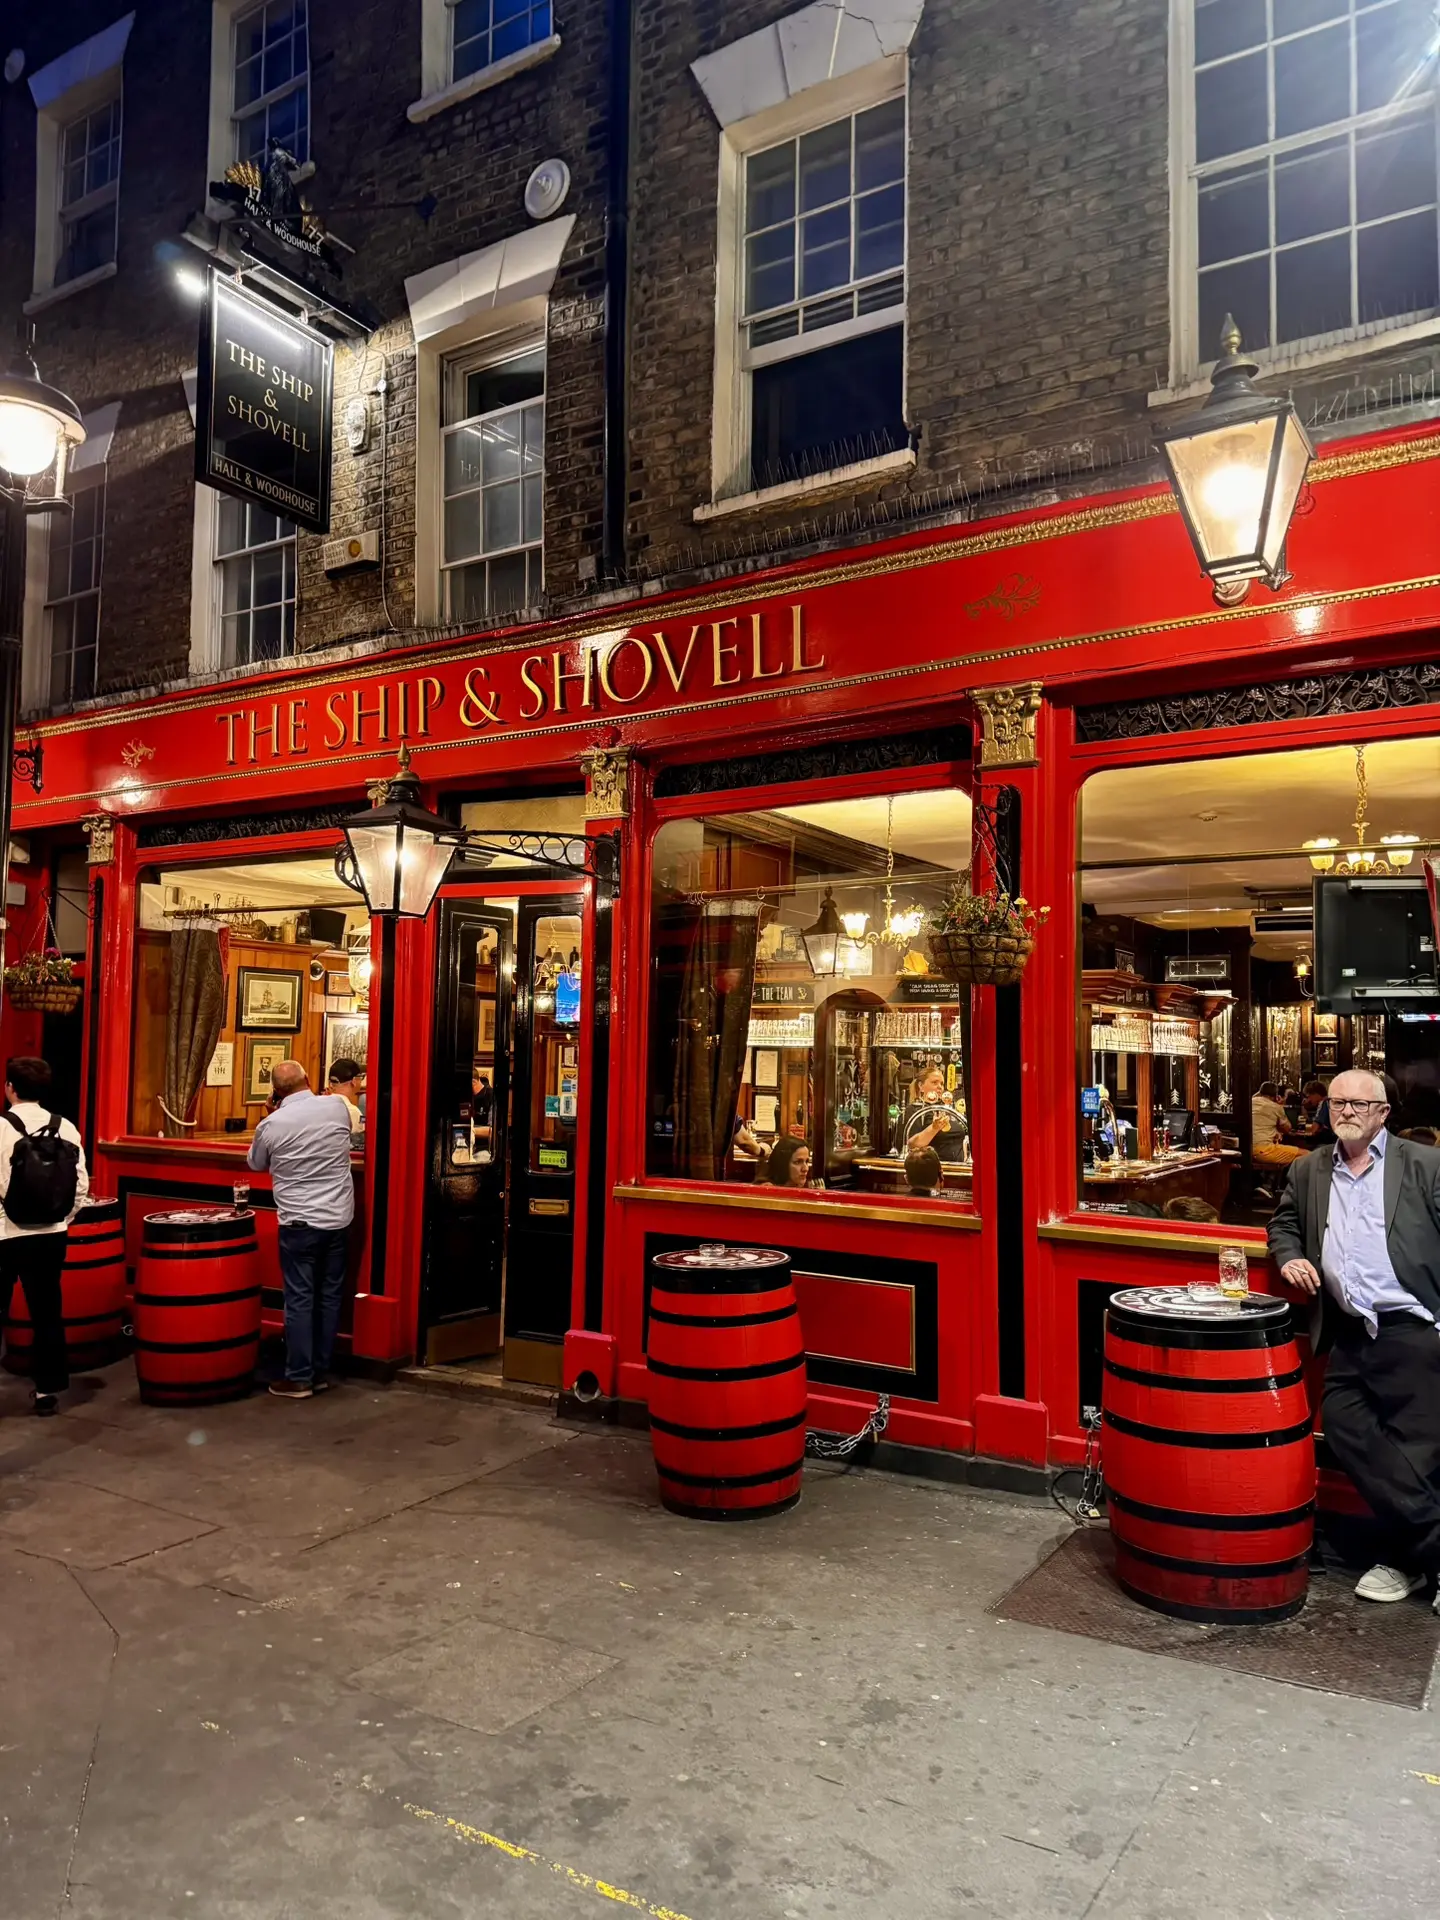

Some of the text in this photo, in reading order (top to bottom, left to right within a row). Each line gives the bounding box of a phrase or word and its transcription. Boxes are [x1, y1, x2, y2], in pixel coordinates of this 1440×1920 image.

[247, 184, 324, 246] 17 77
[274, 223, 321, 257] WOODHOUSE
[226, 339, 313, 402] THE SHIP
[228, 395, 310, 453] SHOVELL
[264, 388, 279, 411] &
[215, 458, 316, 515] HALL & WOODHOUSE
[215, 604, 826, 766] THE SHIP & SHOVELL
[762, 987, 773, 1001] THE
